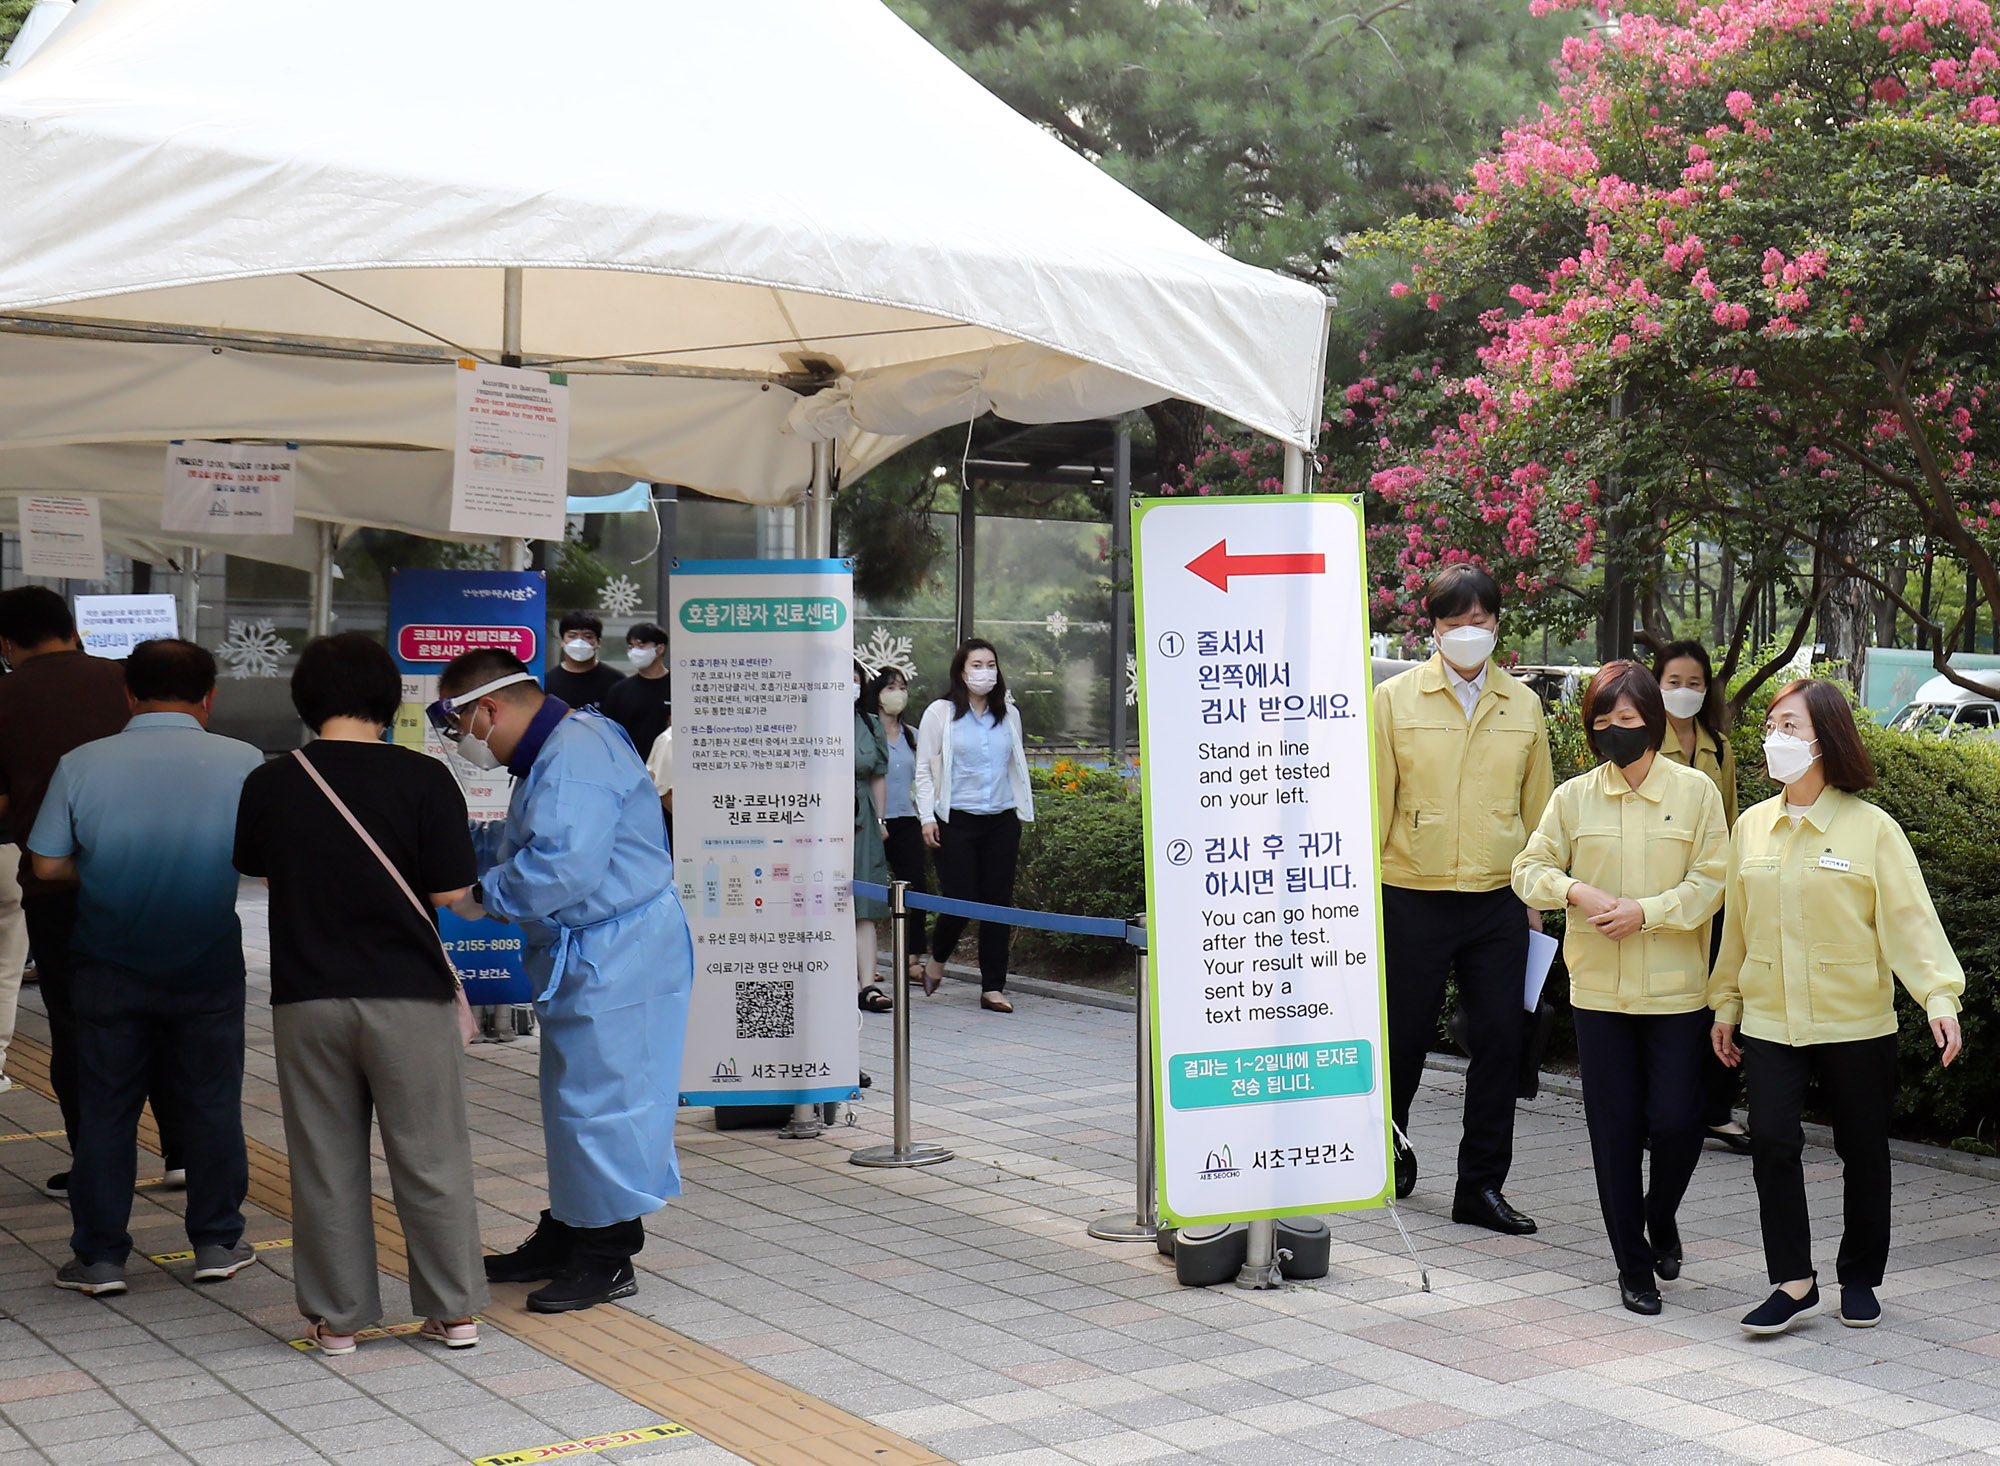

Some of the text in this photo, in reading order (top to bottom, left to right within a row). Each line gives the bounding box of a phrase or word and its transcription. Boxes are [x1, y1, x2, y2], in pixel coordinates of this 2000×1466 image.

[687, 602, 838, 627] 호흡기환자 진료센터
[413, 629, 522, 643] 코로나19 선별진료소
[1197, 629, 1264, 656] 줄서서
[689, 657, 773, 668] 호흡기환자 진료센터란?
[691, 670, 792, 680] 기존 코로나19 관련 의료기관
[1198, 662, 1291, 690] 왼쪽에서
[694, 706, 767, 716] 모두 통합한 의료기관
[1200, 693, 1357, 725] 검사 받으세요.
[691, 723, 798, 735] 원스톱(one-stop) 진료센터란?
[692, 736, 842, 747] 호흡기환자 진료센터 중에서 코로나19 검사
[1198, 739, 1309, 760] Stand in line
[692, 749, 710, 760] (RAT
[712, 749, 728, 759] 또는
[813, 748, 845, 758] 확진자의
[692, 760, 806, 771] 대면진료가 모두 가능한 의료기관
[1199, 762, 1331, 784] and get tested
[712, 793, 822, 809] 진찰·코로나19검사
[1200, 787, 1309, 809] on your left.
[728, 810, 806, 825] 진료 프로세스
[1204, 836, 1250, 864] 검사
[1262, 834, 1285, 861] 후
[1298, 831, 1342, 858] 귀가
[1205, 863, 1357, 898] 하시면 됩니다.
[1202, 902, 1360, 927] You can go home
[457, 938, 521, 952] 2155-8093
[708, 930, 836, 945] 유선 문의 하시고 방문해주세요.
[1202, 928, 1331, 951] after the test.
[706, 959, 829, 974] <의료기관 명단 안내 QR>
[1203, 949, 1367, 976] Your result will be
[478, 967, 511, 980] 보건소
[1204, 980, 1292, 1000] sent by a
[1205, 1001, 1334, 1024] text message.
[751, 1061, 832, 1079] 서초구보건소
[1184, 1046, 1359, 1079] 결과는 1~2일내에 문자로
[1231, 1073, 1315, 1097] 전송 됩니다.
[1252, 1142, 1356, 1170] 서초구보건소
[1200, 1170, 1241, 1181] 서초 SEOCHO
